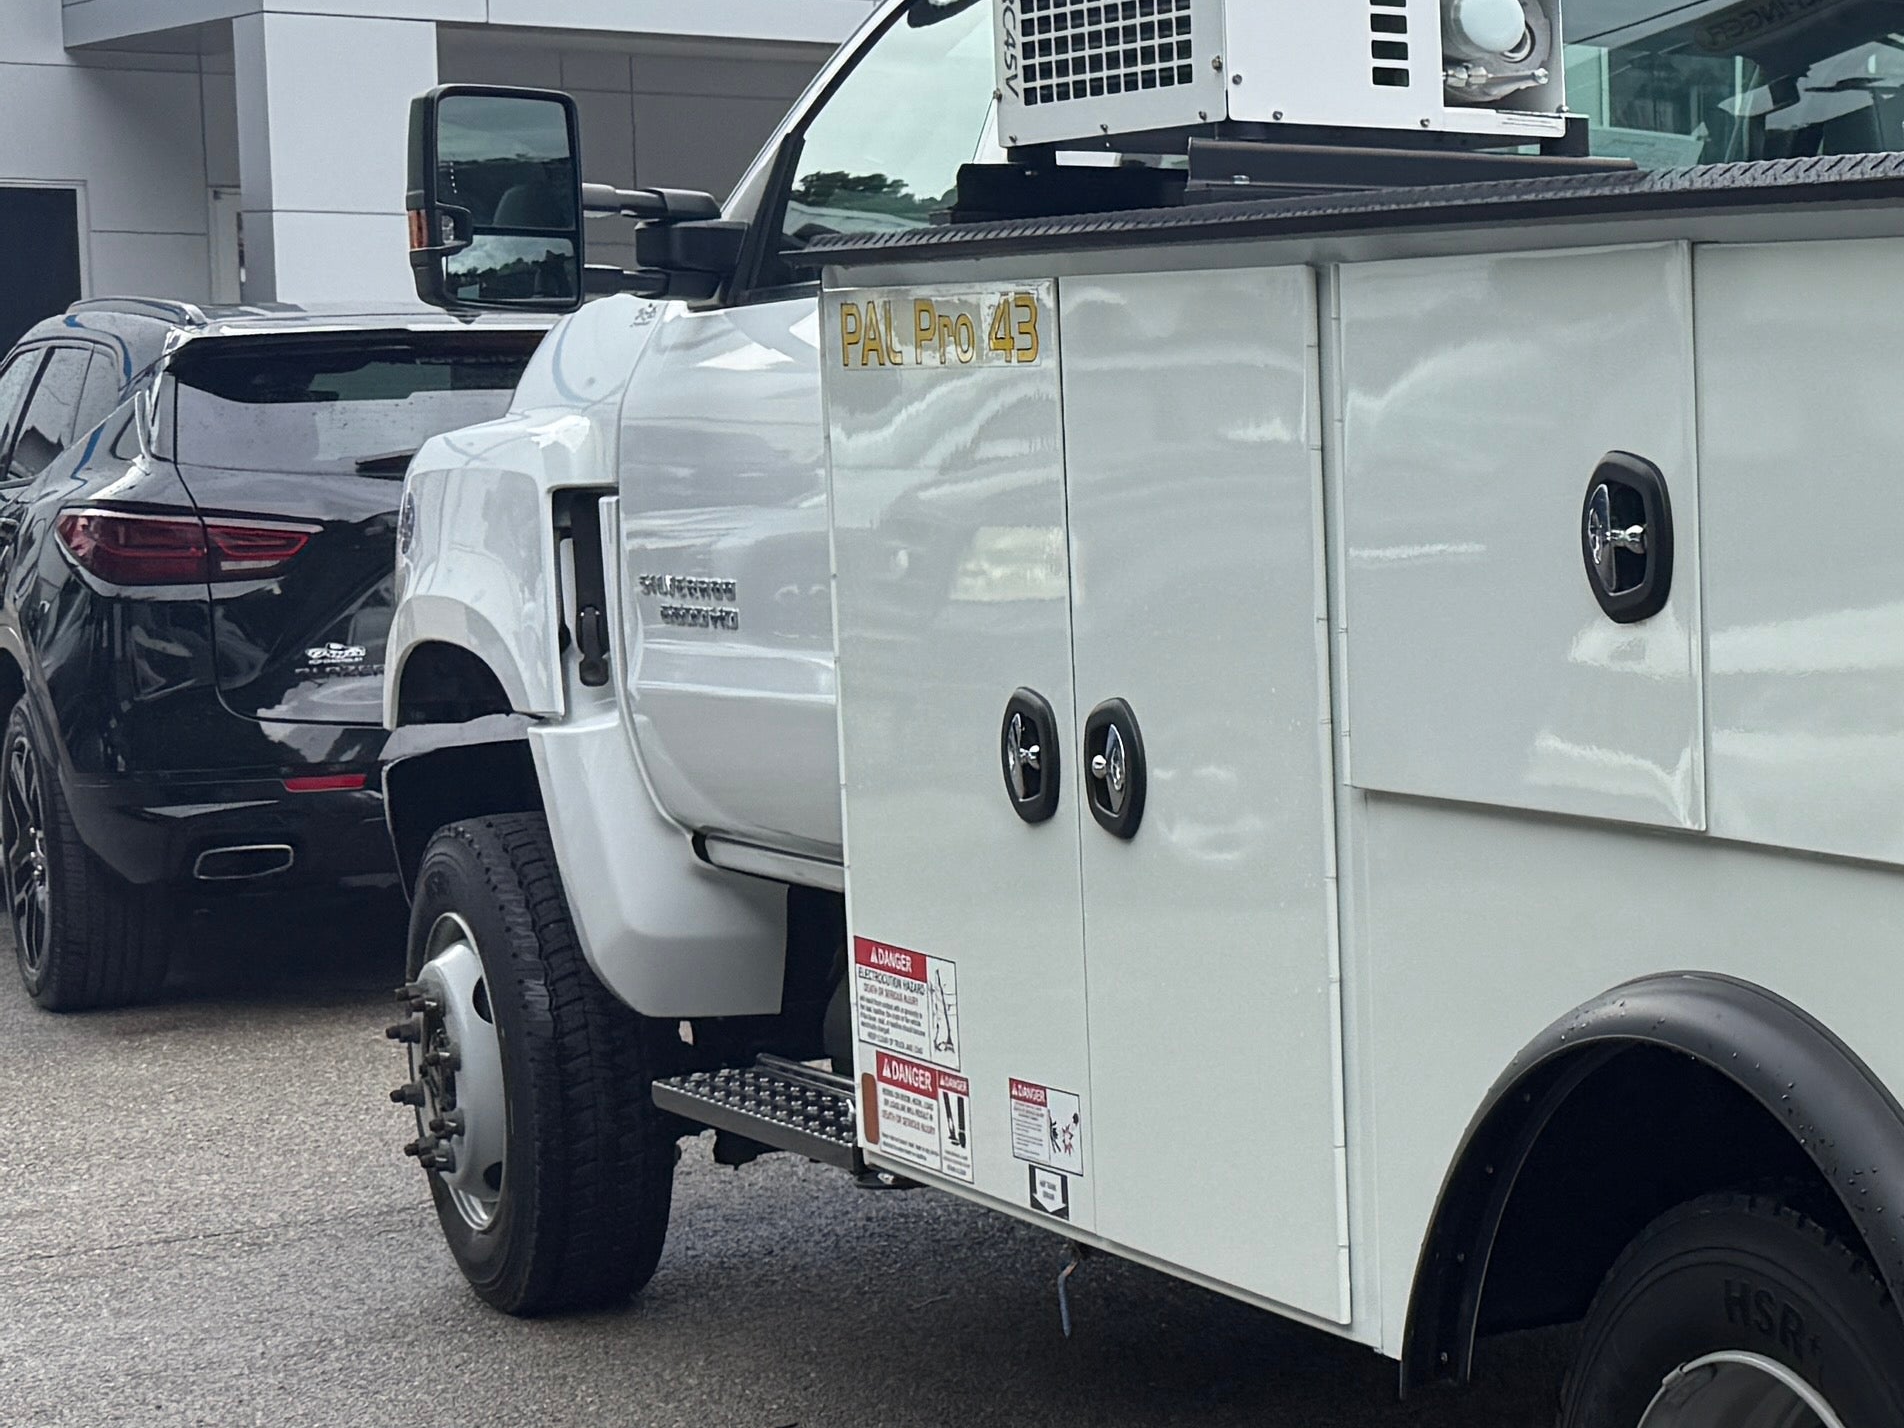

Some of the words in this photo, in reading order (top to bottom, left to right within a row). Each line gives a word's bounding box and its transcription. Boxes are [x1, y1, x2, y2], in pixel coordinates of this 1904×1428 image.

[840, 301, 903, 366] PAL
[914, 298, 975, 364] Pro
[989, 292, 1039, 363] 43
[877, 947, 913, 974] DANGER
[891, 1060, 933, 1092] DANGER
